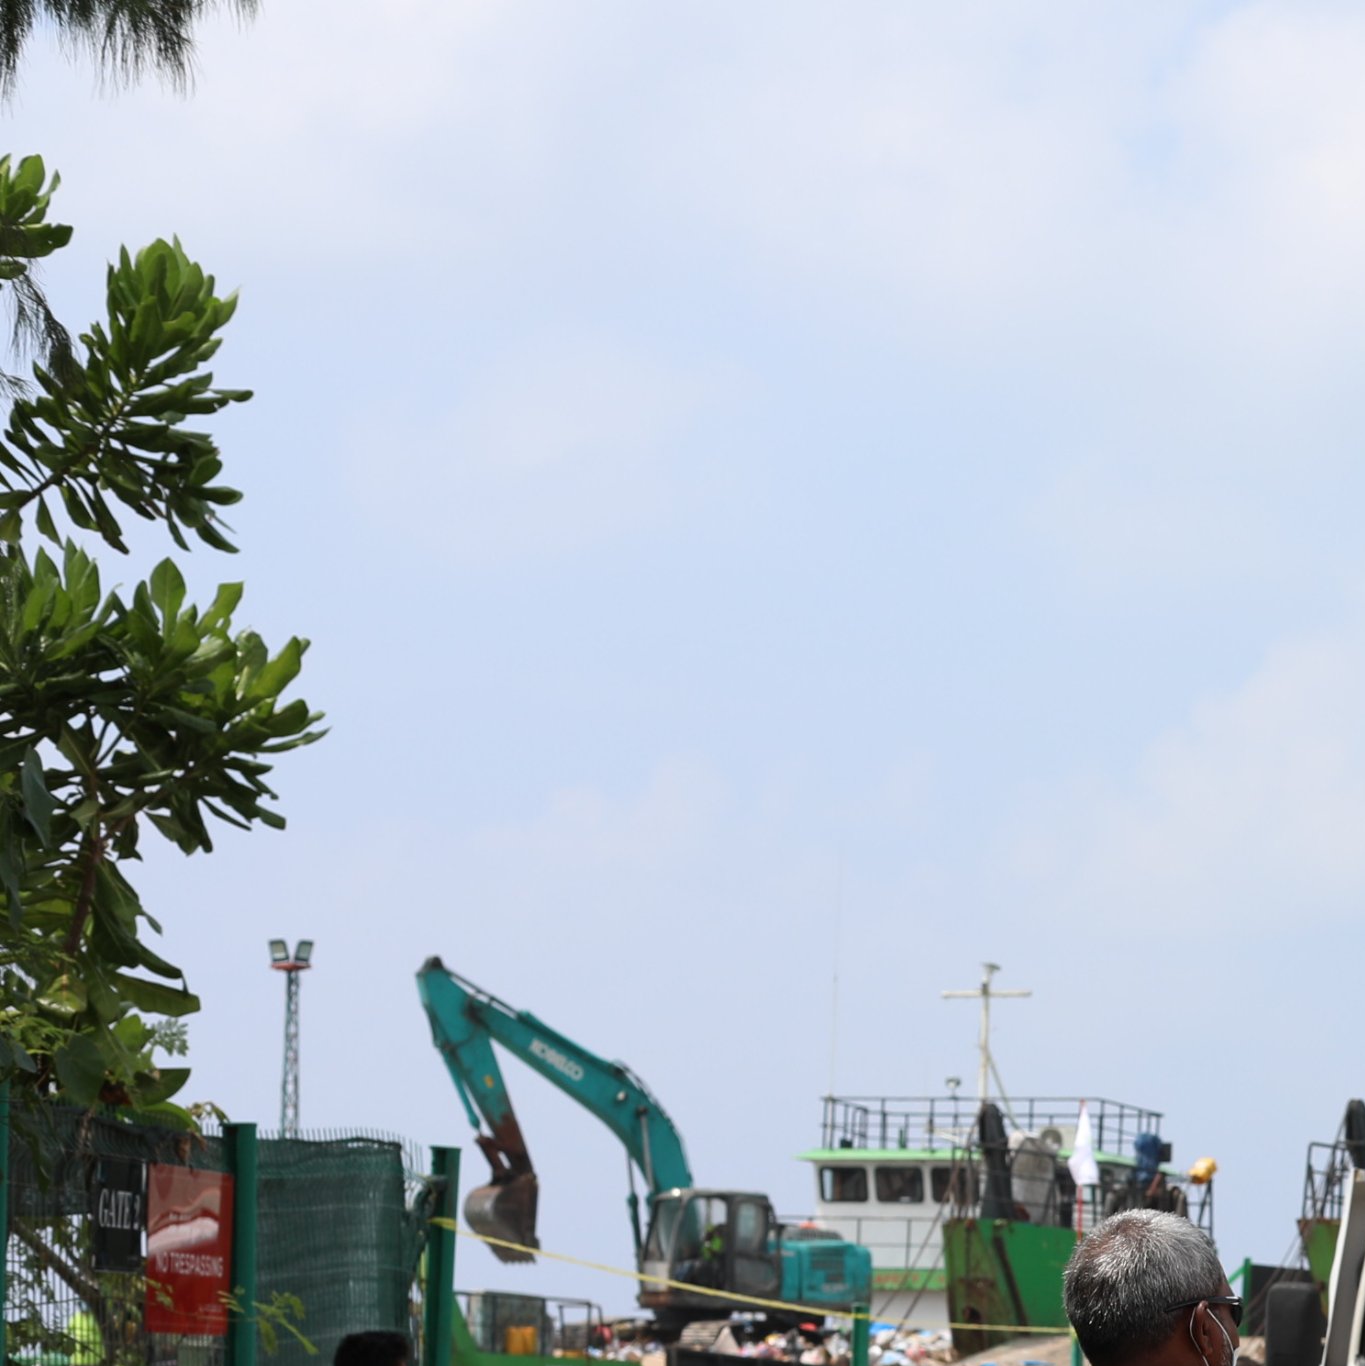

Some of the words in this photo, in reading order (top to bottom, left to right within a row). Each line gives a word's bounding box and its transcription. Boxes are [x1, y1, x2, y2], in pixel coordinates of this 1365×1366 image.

[99, 1188, 131, 1229] GATE
[155, 1252, 168, 1273] NO
[170, 1252, 223, 1278] TRESPASSING
